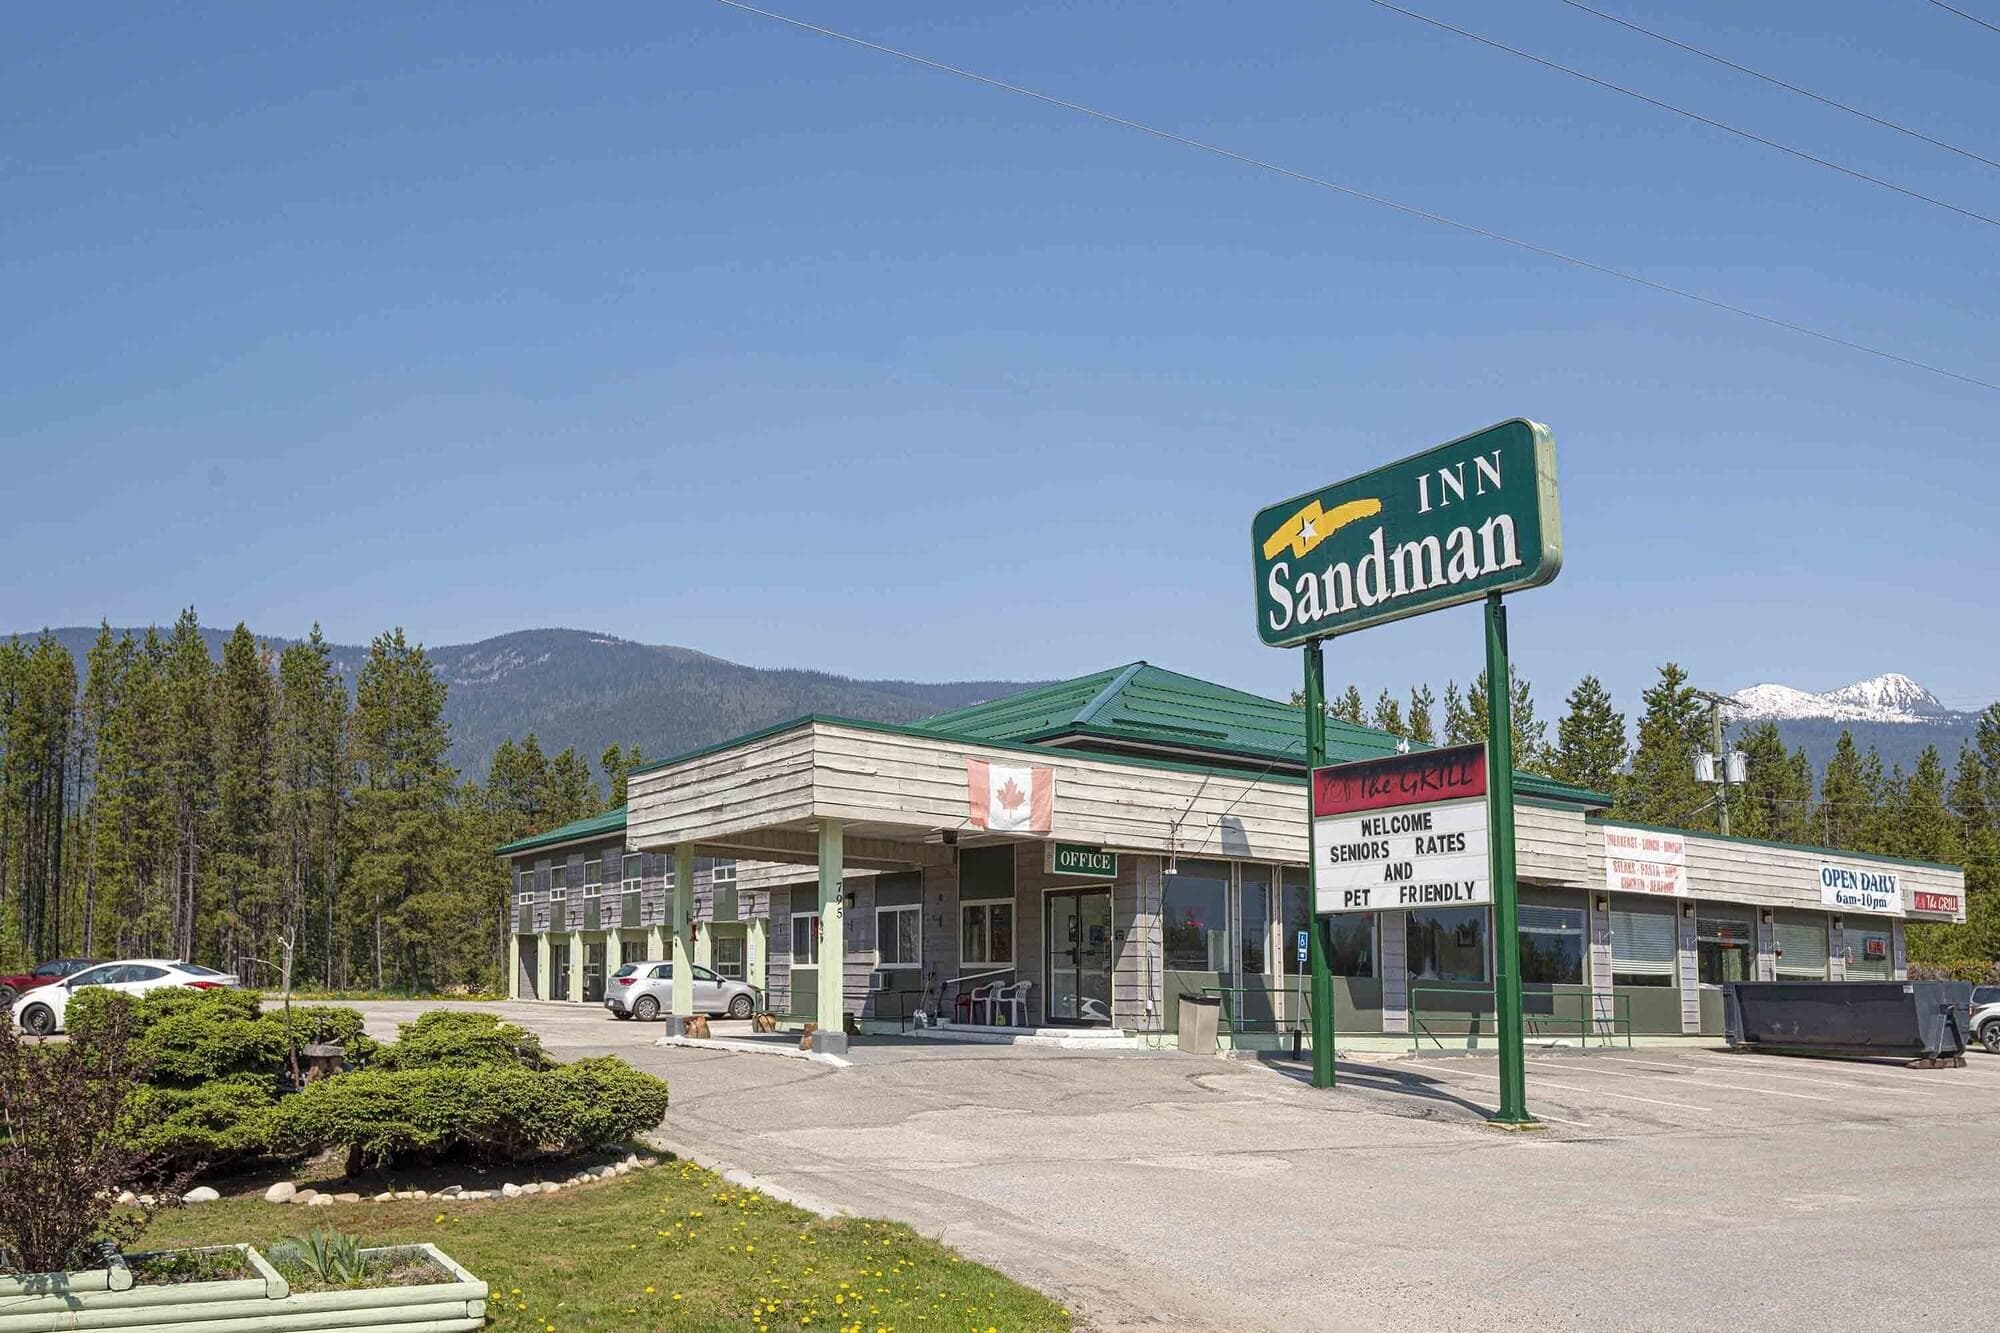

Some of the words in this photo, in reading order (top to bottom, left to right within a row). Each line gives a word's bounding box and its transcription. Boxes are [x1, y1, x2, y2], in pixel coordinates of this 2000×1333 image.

[1417, 450, 1502, 514] INN
[1268, 513, 1522, 631] Sandman
[1361, 769, 1391, 798] The
[1400, 758, 1473, 796] GRILL
[1361, 812, 1432, 837] WELCOME
[1060, 850, 1111, 869] OFFICE
[1330, 840, 1390, 863] SENIORS
[1416, 832, 1466, 855] RATES
[1384, 862, 1413, 881] AND
[1822, 867, 1858, 889] OPEN
[1860, 872, 1896, 893] DAILY
[1344, 889, 1371, 907] PET
[1400, 881, 1475, 903] FRIENDLY
[1836, 889, 1887, 909] 6am-10pm
